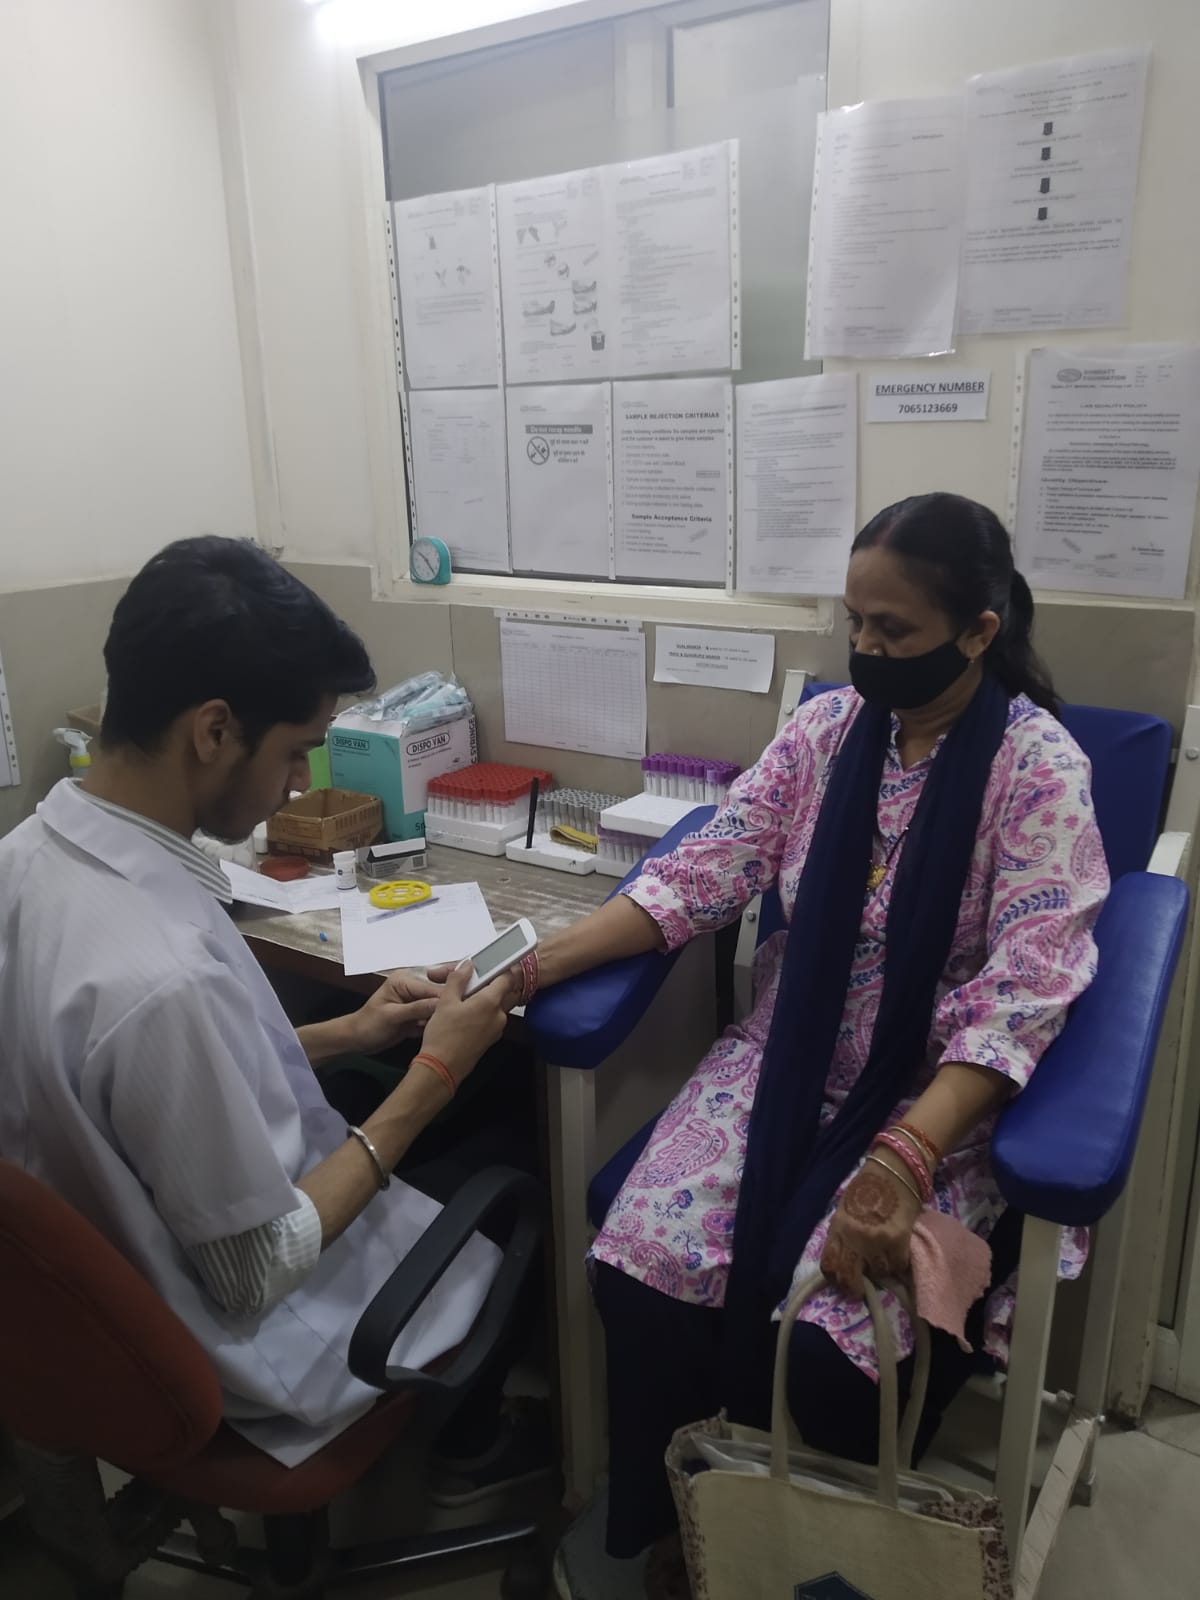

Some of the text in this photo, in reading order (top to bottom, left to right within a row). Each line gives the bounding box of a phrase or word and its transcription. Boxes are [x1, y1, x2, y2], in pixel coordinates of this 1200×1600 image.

[875, 381, 985, 396] EMERGENCY NUMBER
[898, 403, 958, 414] 7065123669
[653, 514, 688, 522] Acceptance
[336, 738, 367, 749] DISPO VAN
[412, 734, 446, 753] DISPO VAN
[468, 719, 477, 755] SYRINGE
